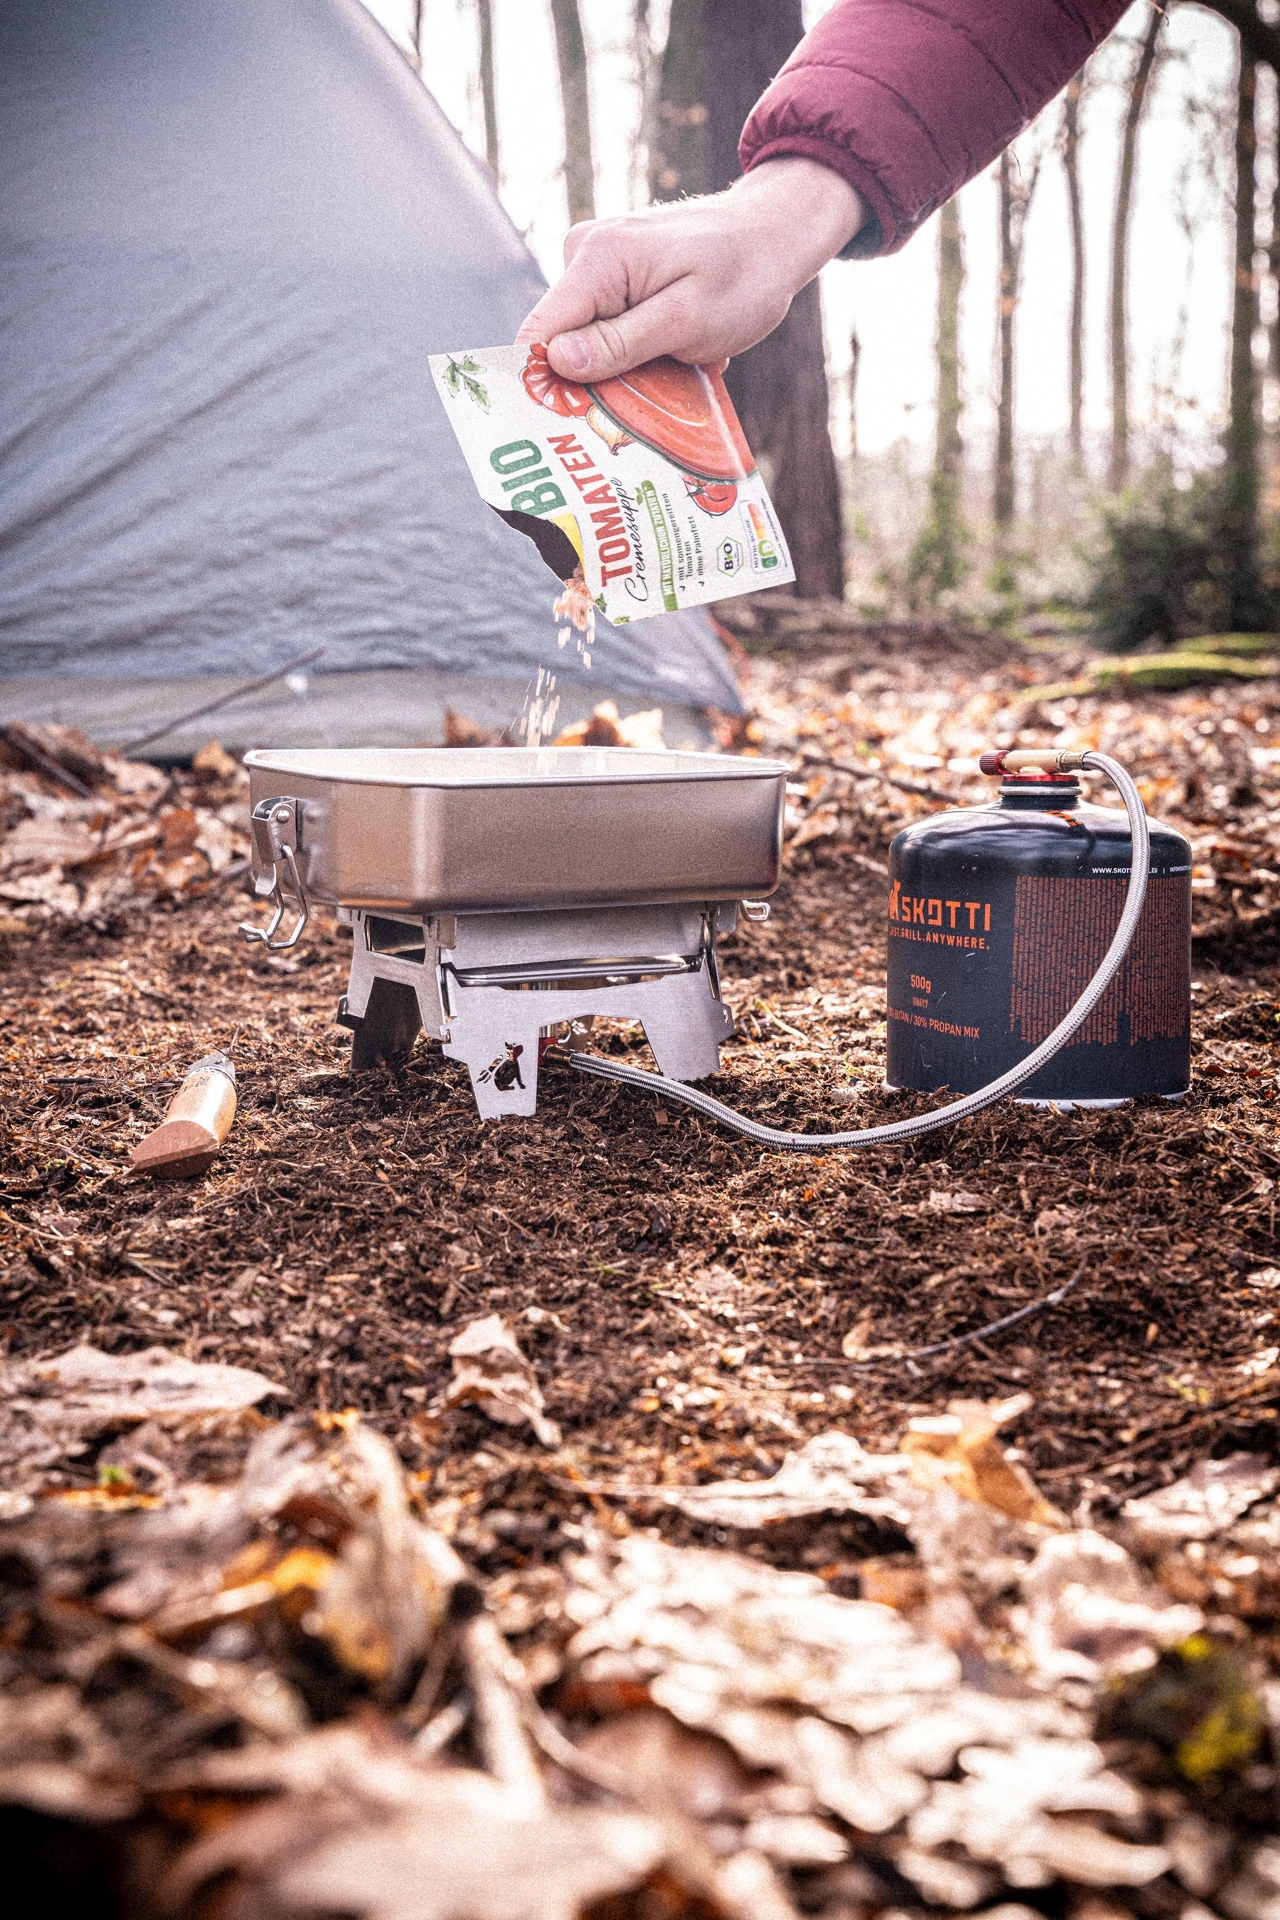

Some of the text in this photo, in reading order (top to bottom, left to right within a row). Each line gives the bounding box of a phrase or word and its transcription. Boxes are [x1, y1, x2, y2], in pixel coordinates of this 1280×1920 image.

[489, 438, 567, 517] BIO
[547, 433, 633, 587] TOMATEN
[662, 493, 684, 564] sonnengereiften
[610, 477, 649, 602] Cremesuppe
[688, 516, 702, 554] Palmfett
[684, 541, 693, 578] Tomaten
[662, 578, 674, 595] MIT
[901, 896, 991, 931] SKOTTI
[910, 974, 931, 994] 500g
[914, 1015, 927, 1028] 30%
[928, 1018, 962, 1037] PROPAN
[963, 1025, 980, 1039] MIX
